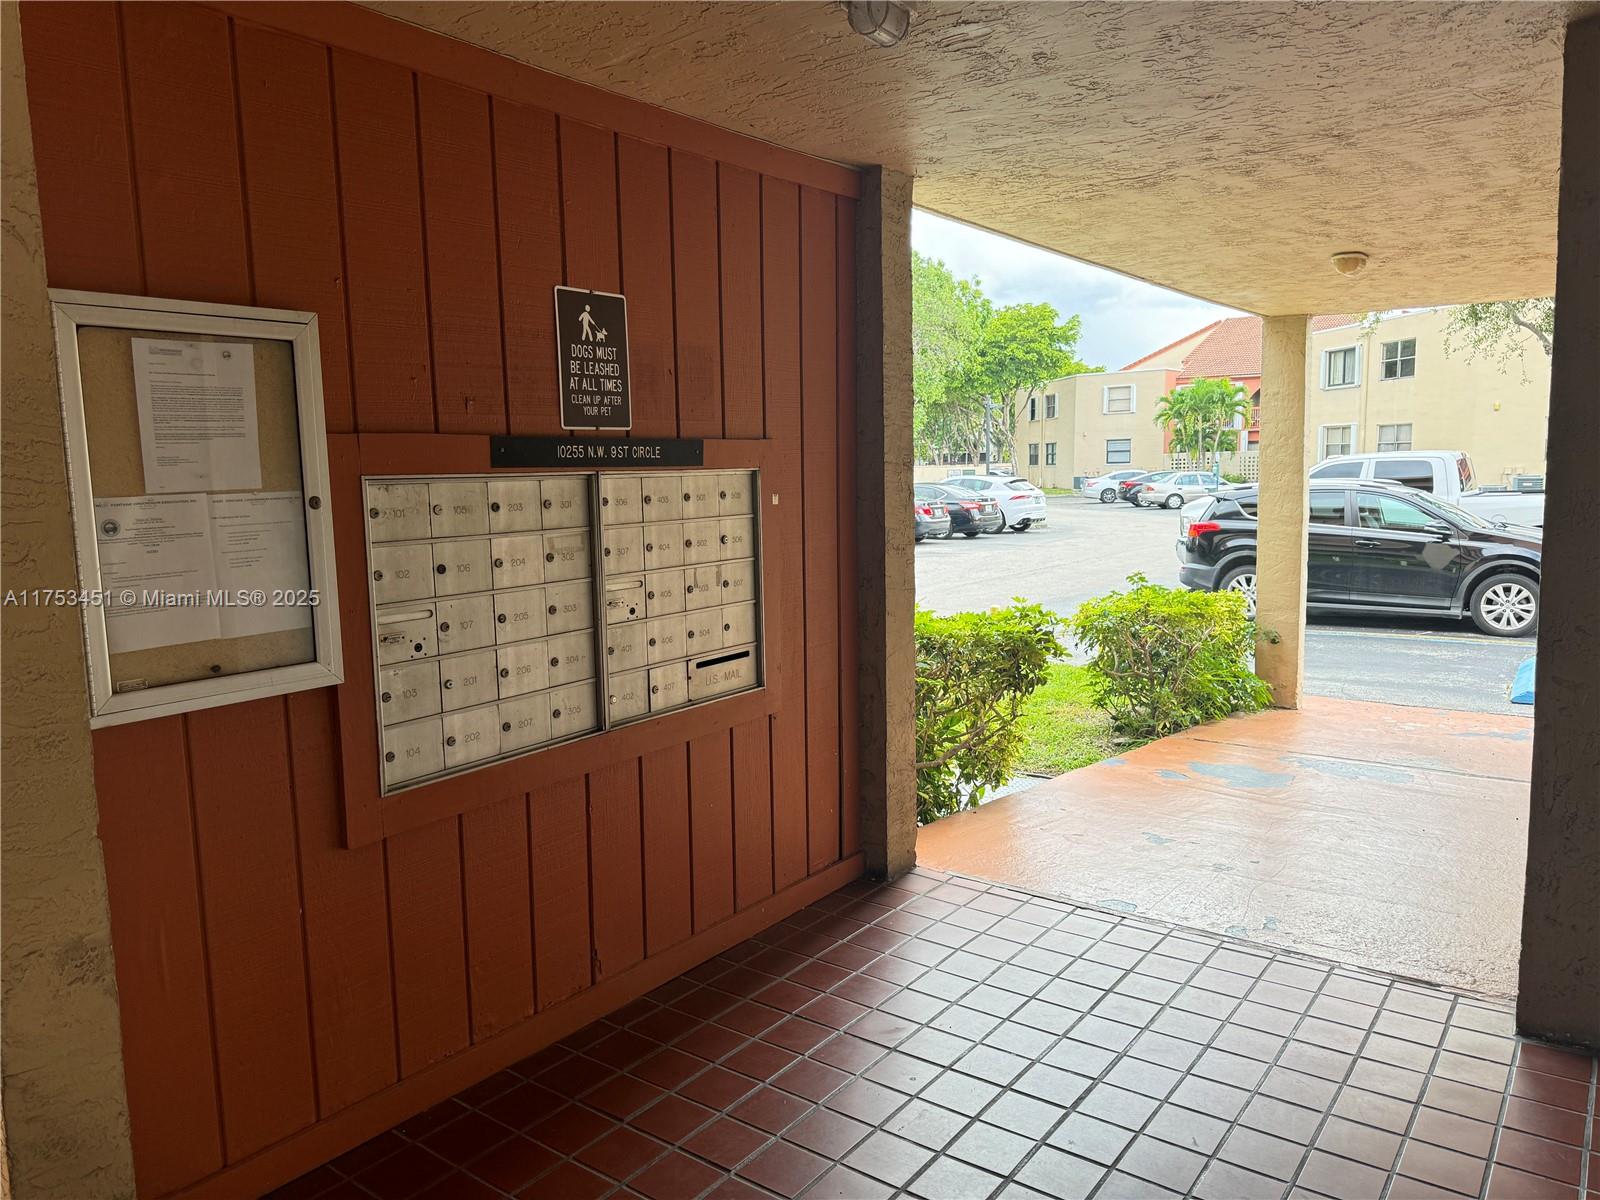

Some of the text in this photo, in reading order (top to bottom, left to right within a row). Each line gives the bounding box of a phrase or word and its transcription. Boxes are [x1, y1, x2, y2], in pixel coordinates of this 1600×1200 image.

[571, 344, 617, 360] DOGS MUST
[570, 360, 620, 376] BE LEASHED
[570, 377, 623, 392] AT ALL TIMES
[571, 394, 622, 406] CLEAN UP AFTER
[583, 406, 612, 416] YOUR PET
[557, 445, 661, 459] 10255 N.W. 9ST CIRCLE
[508, 503, 524, 512] 203
[560, 500, 572, 510] 301
[392, 509, 406, 518] 101
[561, 552, 575, 562] 302
[510, 558, 526, 567] 204
[456, 564, 471, 573] 106
[395, 570, 410, 580] 102
[563, 604, 577, 614] 303
[513, 612, 529, 622] 205
[460, 621, 474, 630] 107
[565, 655, 579, 664] 304
[516, 665, 532, 675] 206
[463, 677, 478, 687] 201
[705, 669, 742, 686] U.S. MAIL
[402, 688, 418, 699] 103
[518, 718, 533, 729] 207
[464, 732, 480, 744] 202
[405, 747, 421, 759] 104
